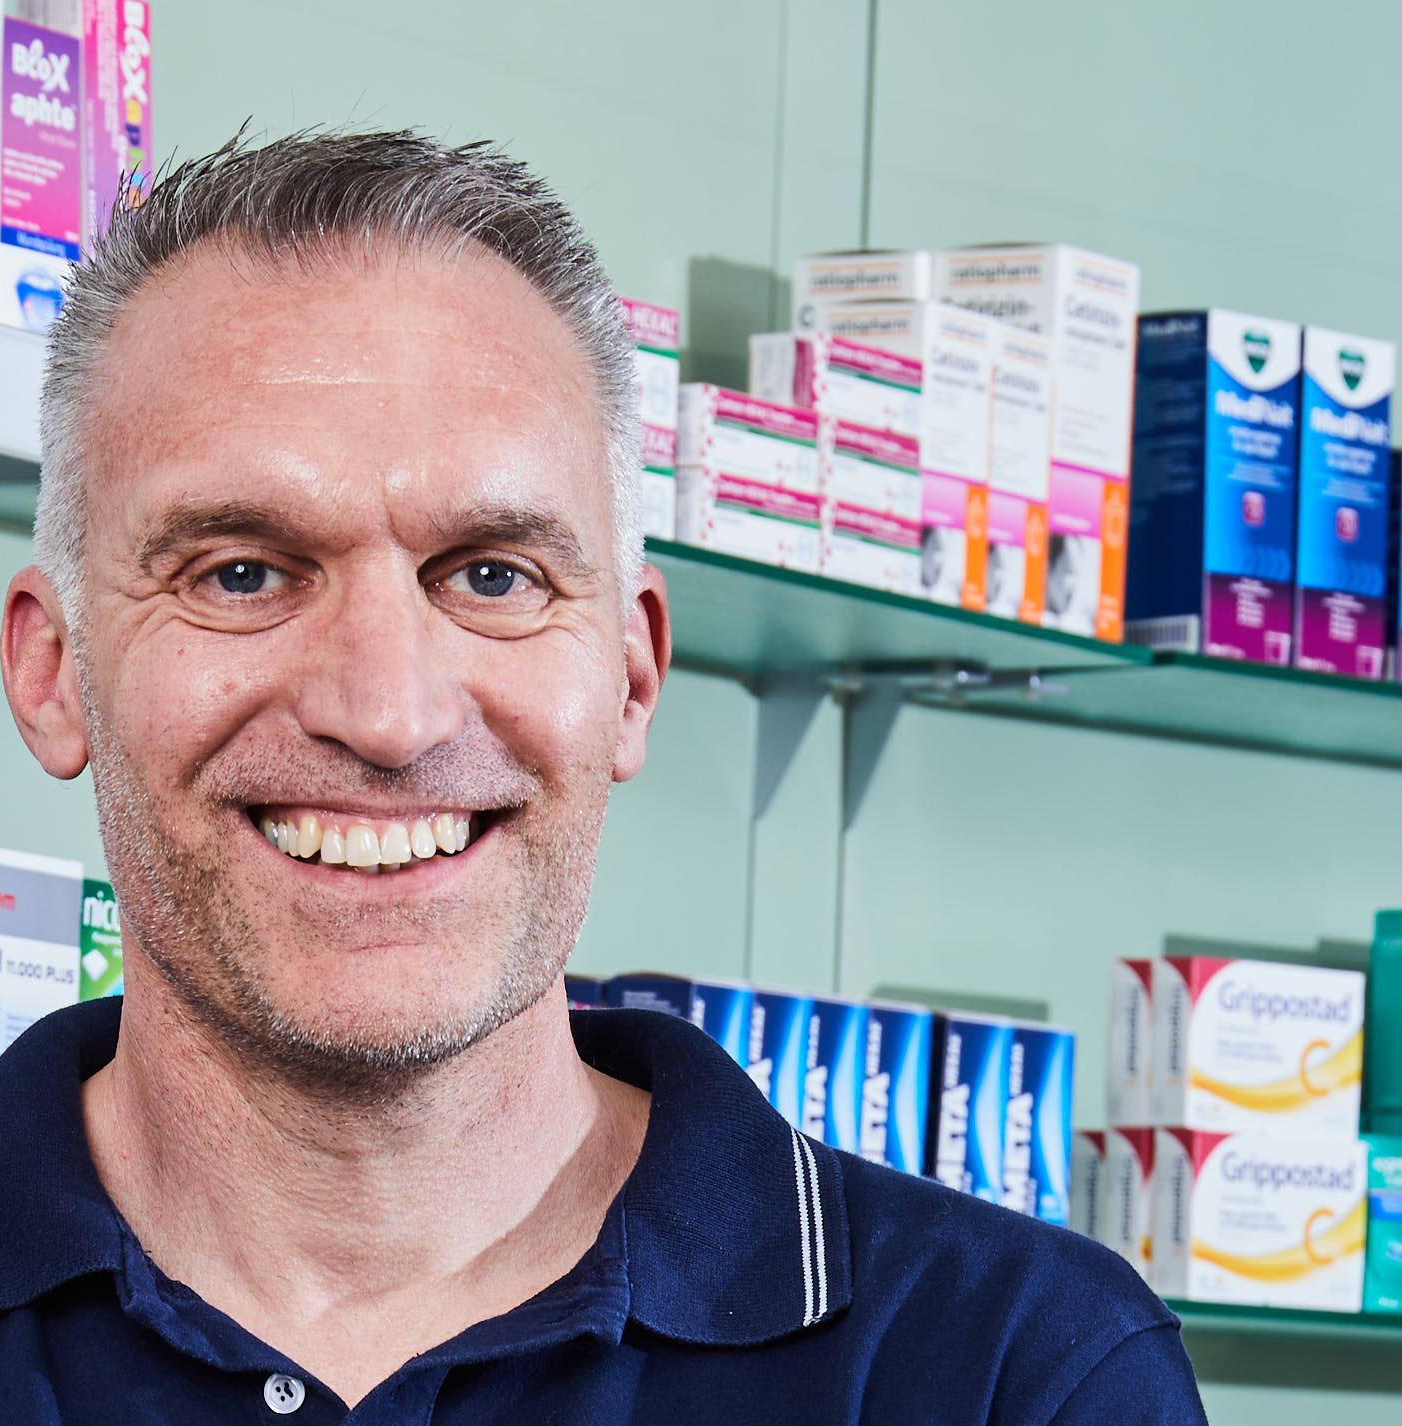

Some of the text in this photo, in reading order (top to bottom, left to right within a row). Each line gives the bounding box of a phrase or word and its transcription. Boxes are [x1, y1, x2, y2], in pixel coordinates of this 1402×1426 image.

[46, 961, 75, 984] PLUS
[1218, 980, 1351, 1024] Grippostad
[1220, 1151, 1355, 1193] Grippostad
